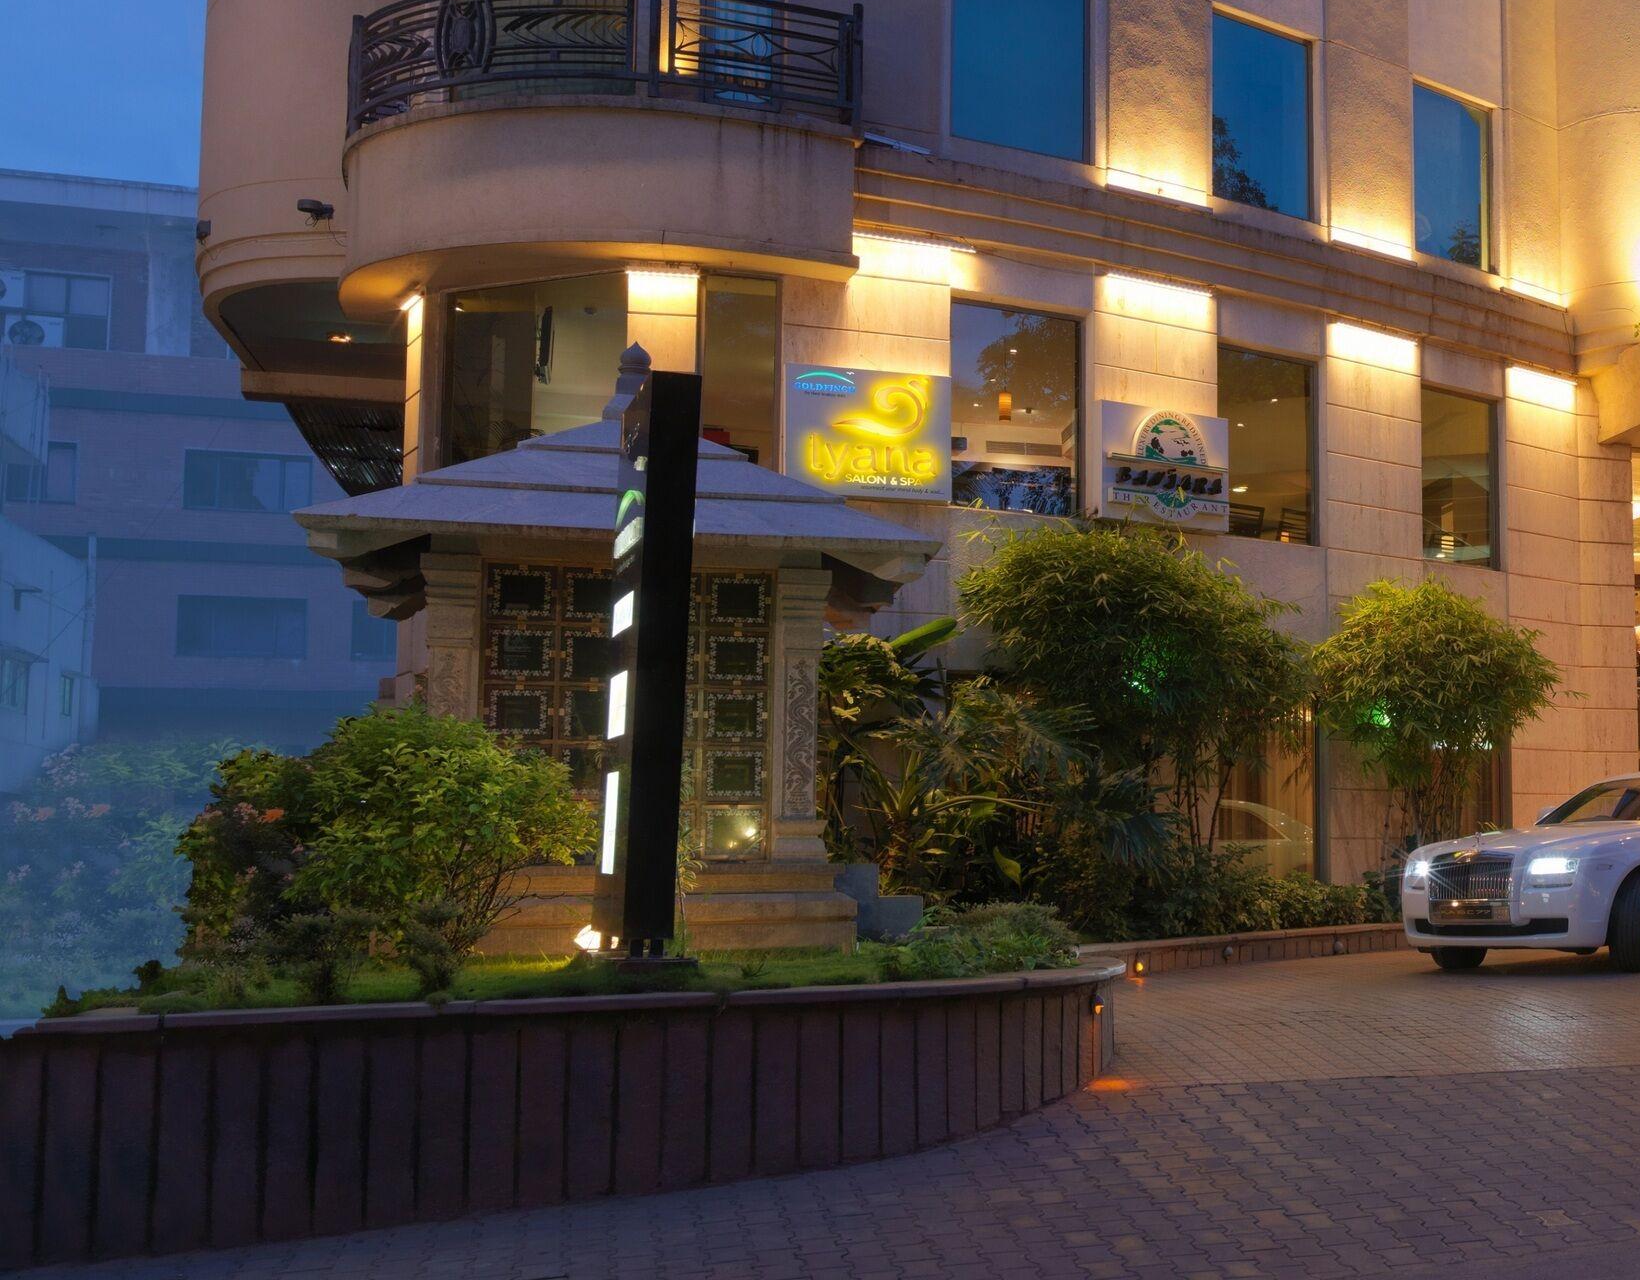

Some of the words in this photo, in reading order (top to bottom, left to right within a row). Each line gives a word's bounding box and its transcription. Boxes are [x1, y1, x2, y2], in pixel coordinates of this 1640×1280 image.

[1151, 411, 1180, 425] DINING
[1181, 418, 1207, 465] REDEFINED
[845, 473, 887, 485] SALON
[890, 476, 898, 486] &
[899, 477, 924, 487] SPA
[1144, 495, 1228, 519] RESTAURANT
